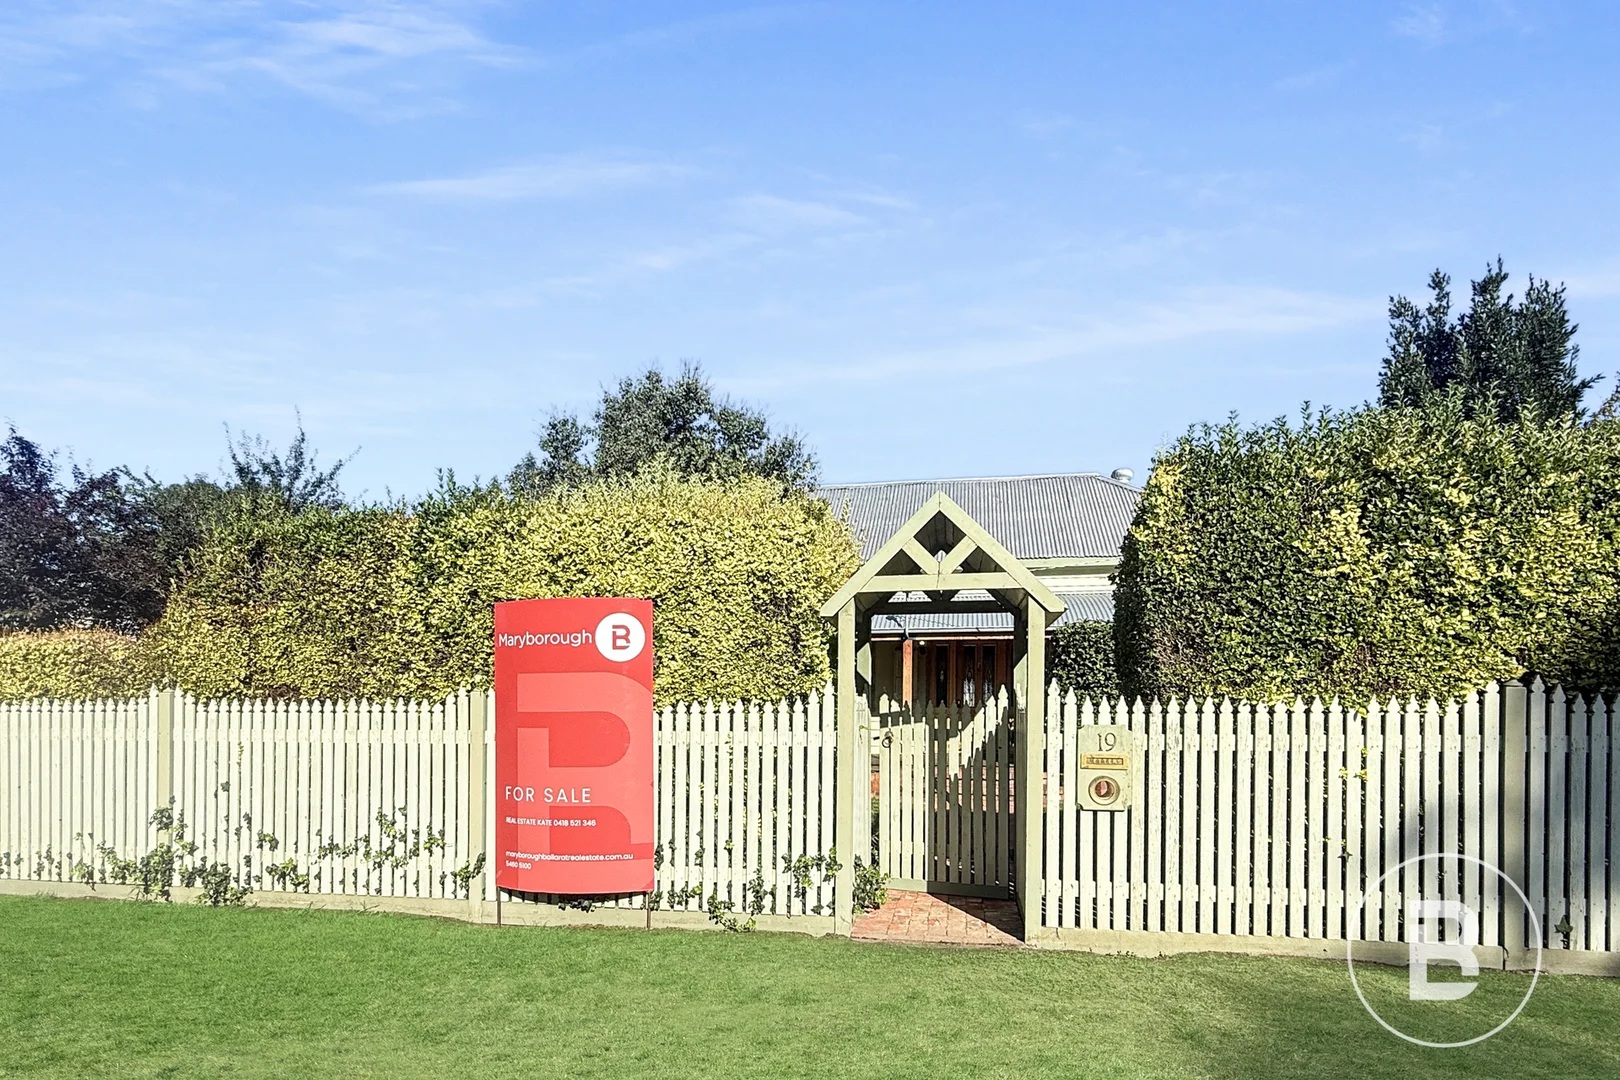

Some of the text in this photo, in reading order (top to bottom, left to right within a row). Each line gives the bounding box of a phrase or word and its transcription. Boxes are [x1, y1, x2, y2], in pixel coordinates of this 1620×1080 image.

[498, 629, 592, 648] Maryborough
[612, 624, 631, 650] B
[1097, 732, 1117, 752] 19
[505, 786, 591, 803] FOR SALE
[505, 816, 517, 824] REAL
[517, 818, 536, 826] ESTATE
[537, 819, 553, 827] KATE
[553, 819, 569, 827] 0418
[570, 819, 581, 827] 521
[505, 851, 634, 862] maryboroughballaratrealestate.com.au
